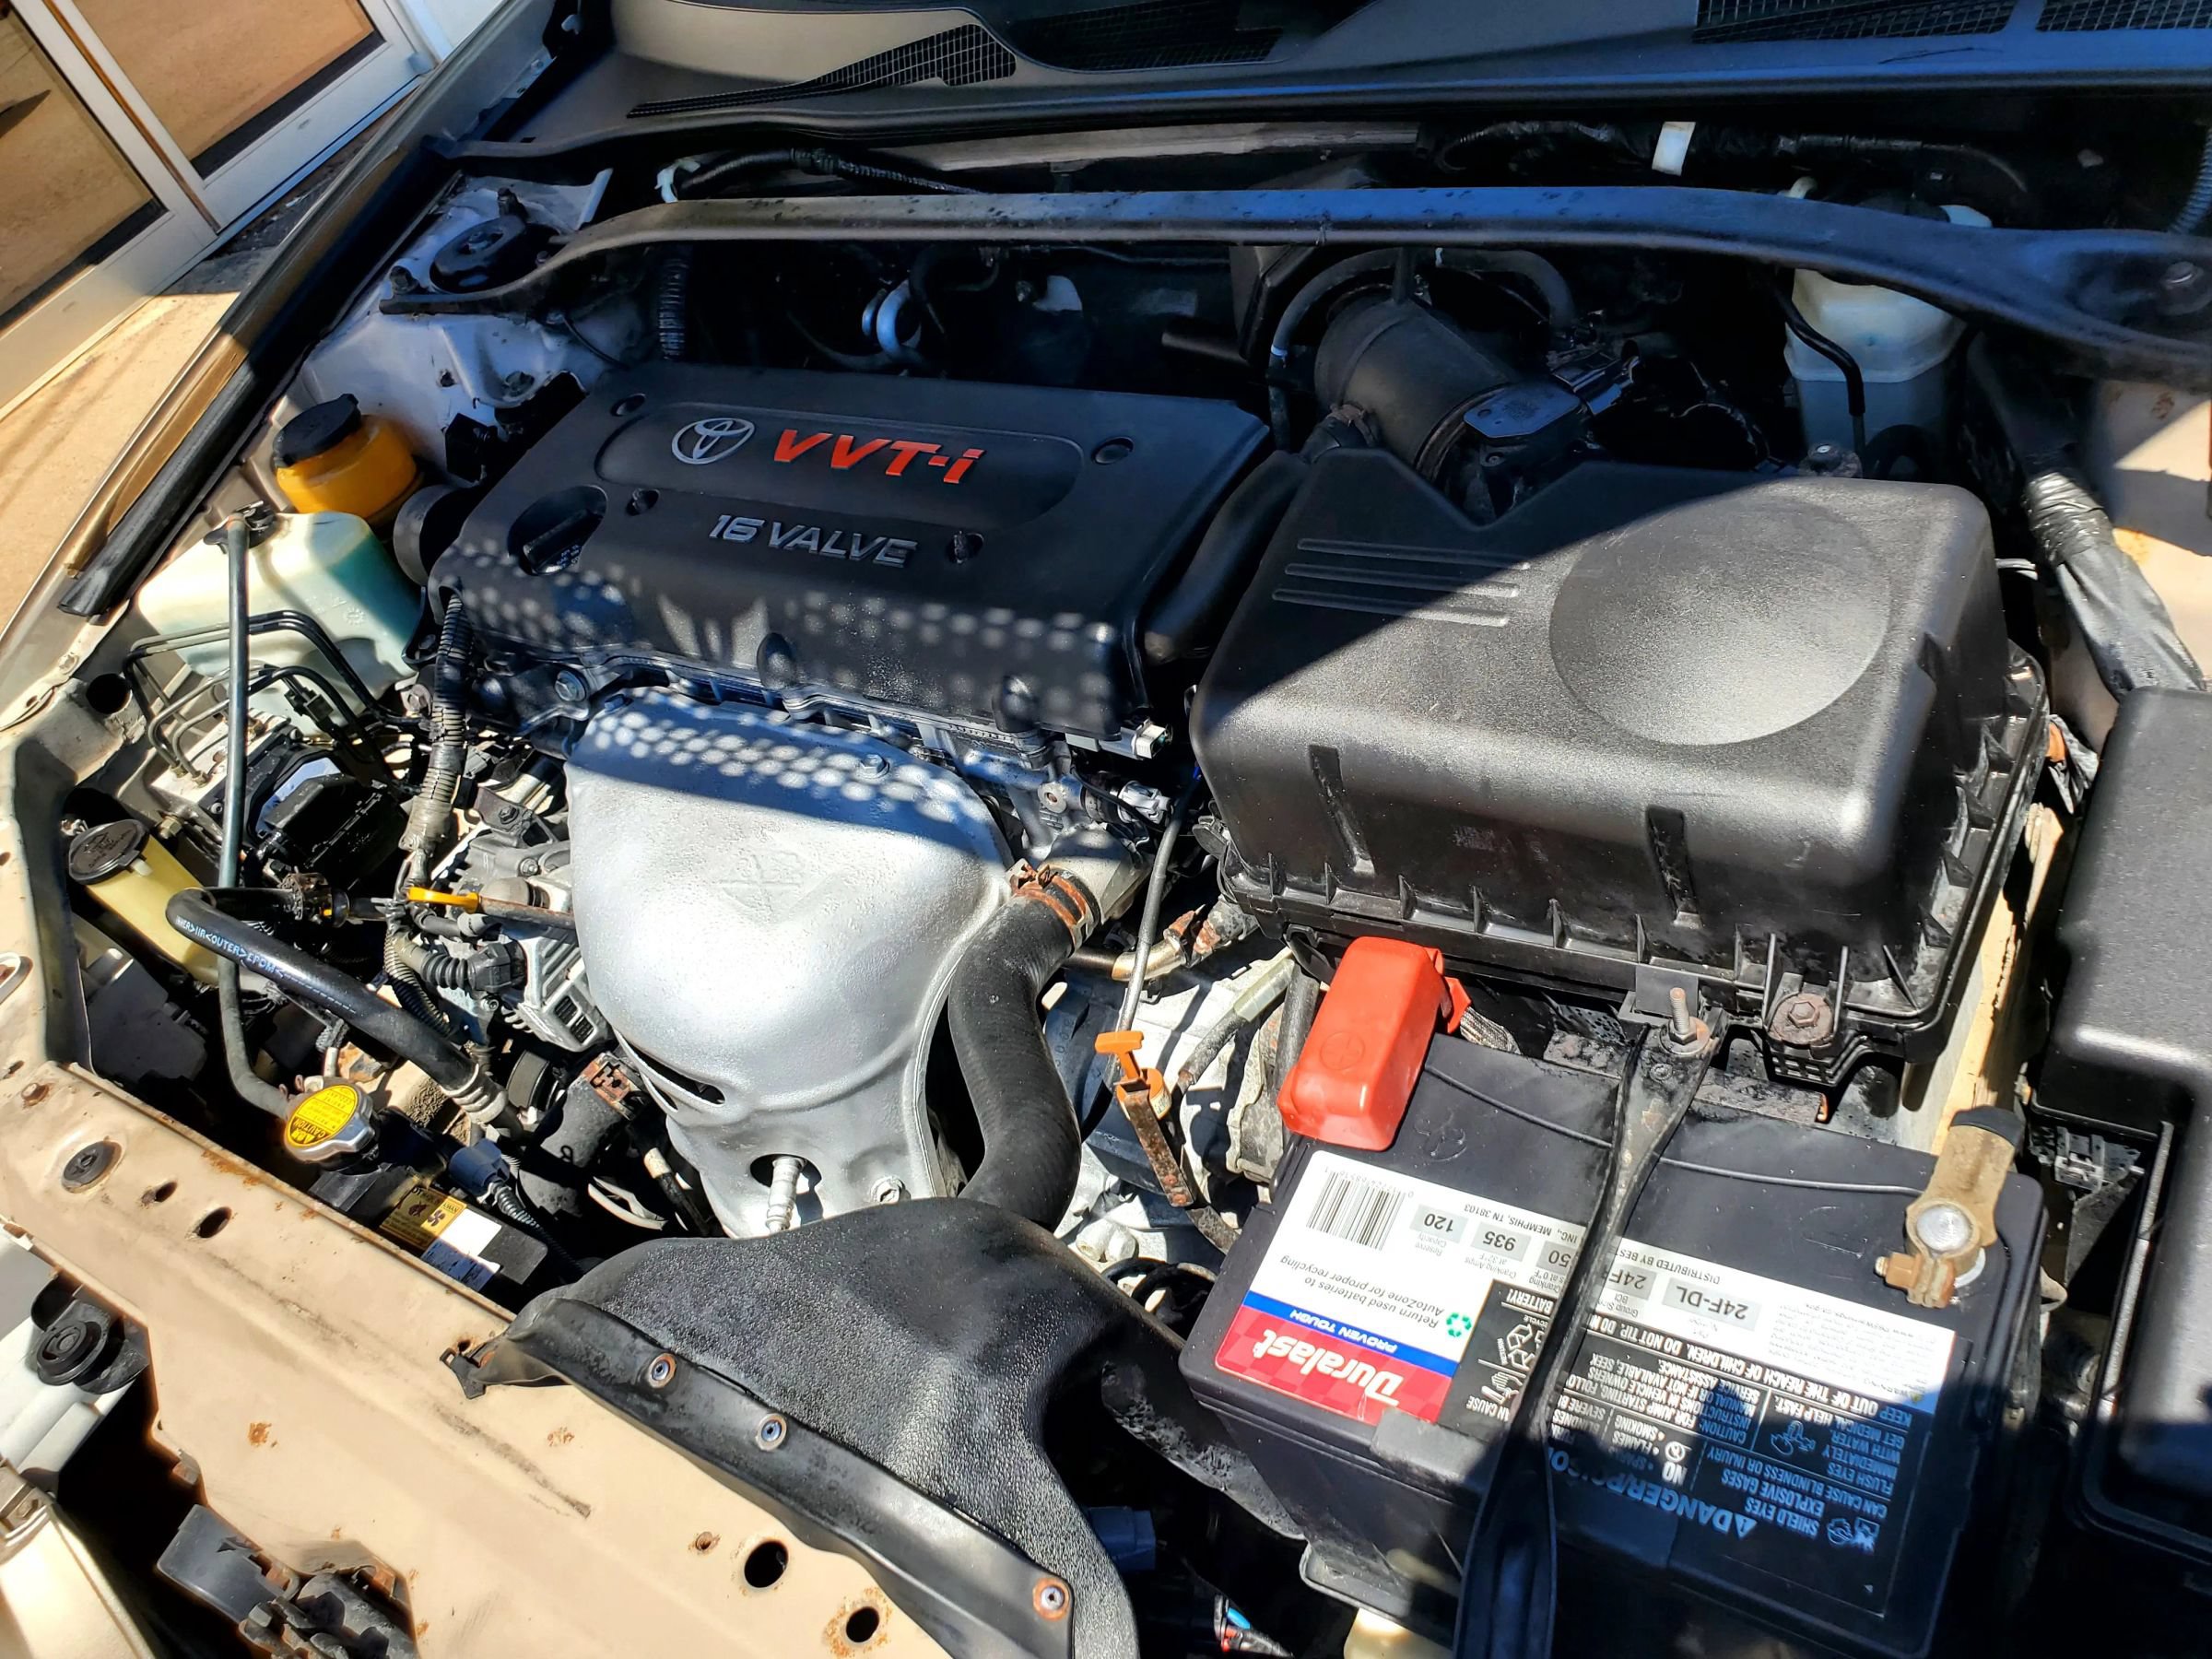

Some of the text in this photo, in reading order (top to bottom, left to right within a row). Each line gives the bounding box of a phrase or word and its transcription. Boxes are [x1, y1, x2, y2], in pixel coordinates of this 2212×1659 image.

[773, 429, 986, 485] VVT-i
[708, 514, 920, 568] 16 VALVE
[293, 1117, 326, 1138] CAUTION
[1463, 1203, 1491, 1218] 38103
[1491, 1211, 1505, 1221] TN
[1422, 1212, 1456, 1233] 120
[1505, 1214, 1553, 1235] MEMPHIS,
[1413, 1231, 1448, 1256] Reserve Capacity
[1481, 1230, 1517, 1252] 935
[1464, 1255, 1517, 1278] Cranking Amps
[1498, 1257, 1507, 1265] at
[1641, 1254, 1654, 1265] BY
[1655, 1258, 1720, 1284] DISTRIBUTED
[1278, 1253, 1445, 1318] AutoZone for proper recycling
[1549, 1273, 1559, 1281] at
[1302, 1276, 1439, 1328] Return used batteries to
[1505, 1288, 1554, 1314] BATTERY!
[1613, 1292, 1629, 1303] BCI
[1672, 1285, 1748, 1321] 24F-DL
[1522, 1313, 1548, 1328] ECYCLE
[1614, 1302, 1639, 1317] Group
[1288, 1308, 1398, 1354] PROVEN TOUGH
[1599, 1317, 1618, 1335] DO
[1618, 1323, 1640, 1342] TIP.
[1638, 1329, 1664, 1349] NOT
[1662, 1336, 1683, 1356] DO
[1250, 1326, 1408, 1408] Duralast
[1682, 1343, 1746, 1375] CHILDREN.
[1654, 1358, 1760, 1403] SERVICE ASSISTANCE.
[1742, 1361, 1762, 1381] OF
[1762, 1368, 1805, 1394] REACH
[1565, 1372, 1598, 1394] FOLLO
[1589, 1352, 1756, 1417] MANUAL OR IF NOT AVAILABLE, SEEK
[1804, 1381, 1830, 1403] THE
[1465, 1394, 1498, 1417] CAUSE
[1586, 1365, 1751, 1430] INSTRUCTIONS IN VEHICLE OWNERS
[1596, 1382, 1647, 1410] STARTING,
[1830, 1389, 1851, 1409] OF
[1849, 1395, 1878, 1418] OUT
[1567, 1397, 1606, 1421] SEVERE
[1647, 1400, 1676, 1419] JUMP
[1674, 1409, 1696, 1427] FOR
[1878, 1405, 1912, 1427] KEEP
[1551, 1407, 1600, 1436] BLINDNES
[1612, 1413, 1659, 1441] SMOKING
[1771, 1395, 1905, 1449] GET MEDICAL HELP FAST.
[1610, 1430, 1653, 1455] FLAMES
[1868, 1442, 1901, 1464] WITH
[1659, 1459, 1688, 1486] NO
[1821, 1443, 1898, 1479] IMMEDIATELY
[1707, 1444, 1888, 1519] CAN CAUSE BLINDNESS OR INJURY
[1826, 1461, 1893, 1495] FLUSH EYES
[1720, 1466, 1825, 1517] EXPLOSIVE GASES
[1743, 1496, 1820, 1536] SHIELD EYES
